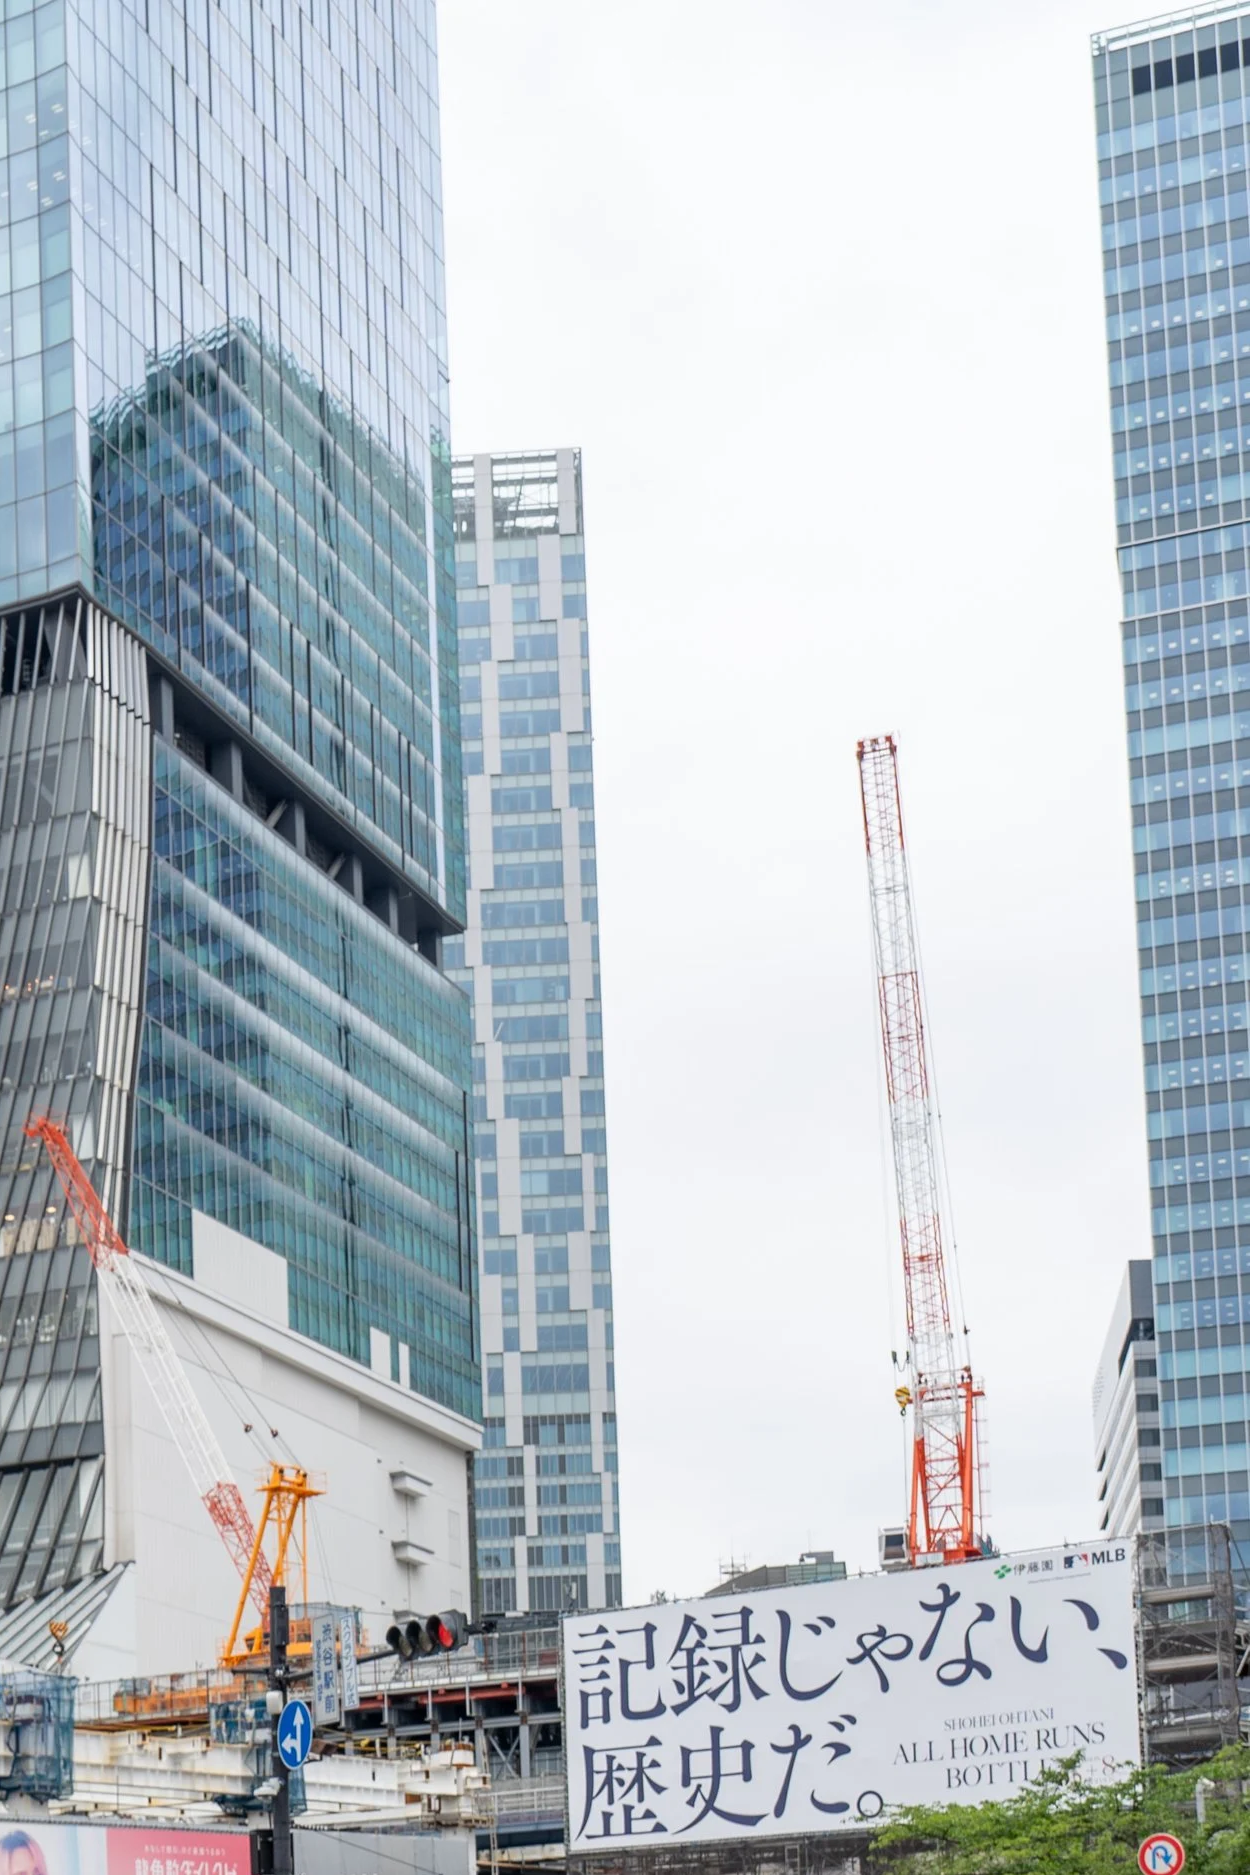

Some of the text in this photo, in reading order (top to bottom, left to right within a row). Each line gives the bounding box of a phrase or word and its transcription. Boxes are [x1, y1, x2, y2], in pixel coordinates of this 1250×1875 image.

[1091, 1548, 1126, 1565] MLB
[572, 1582, 1128, 1730] 記録じゃない、
[943, 1707, 1055, 1732] SHOHEI OHTANI
[893, 1721, 1106, 1765] ALL HOME RUNS
[574, 1713, 884, 1840] 歴史だ。
